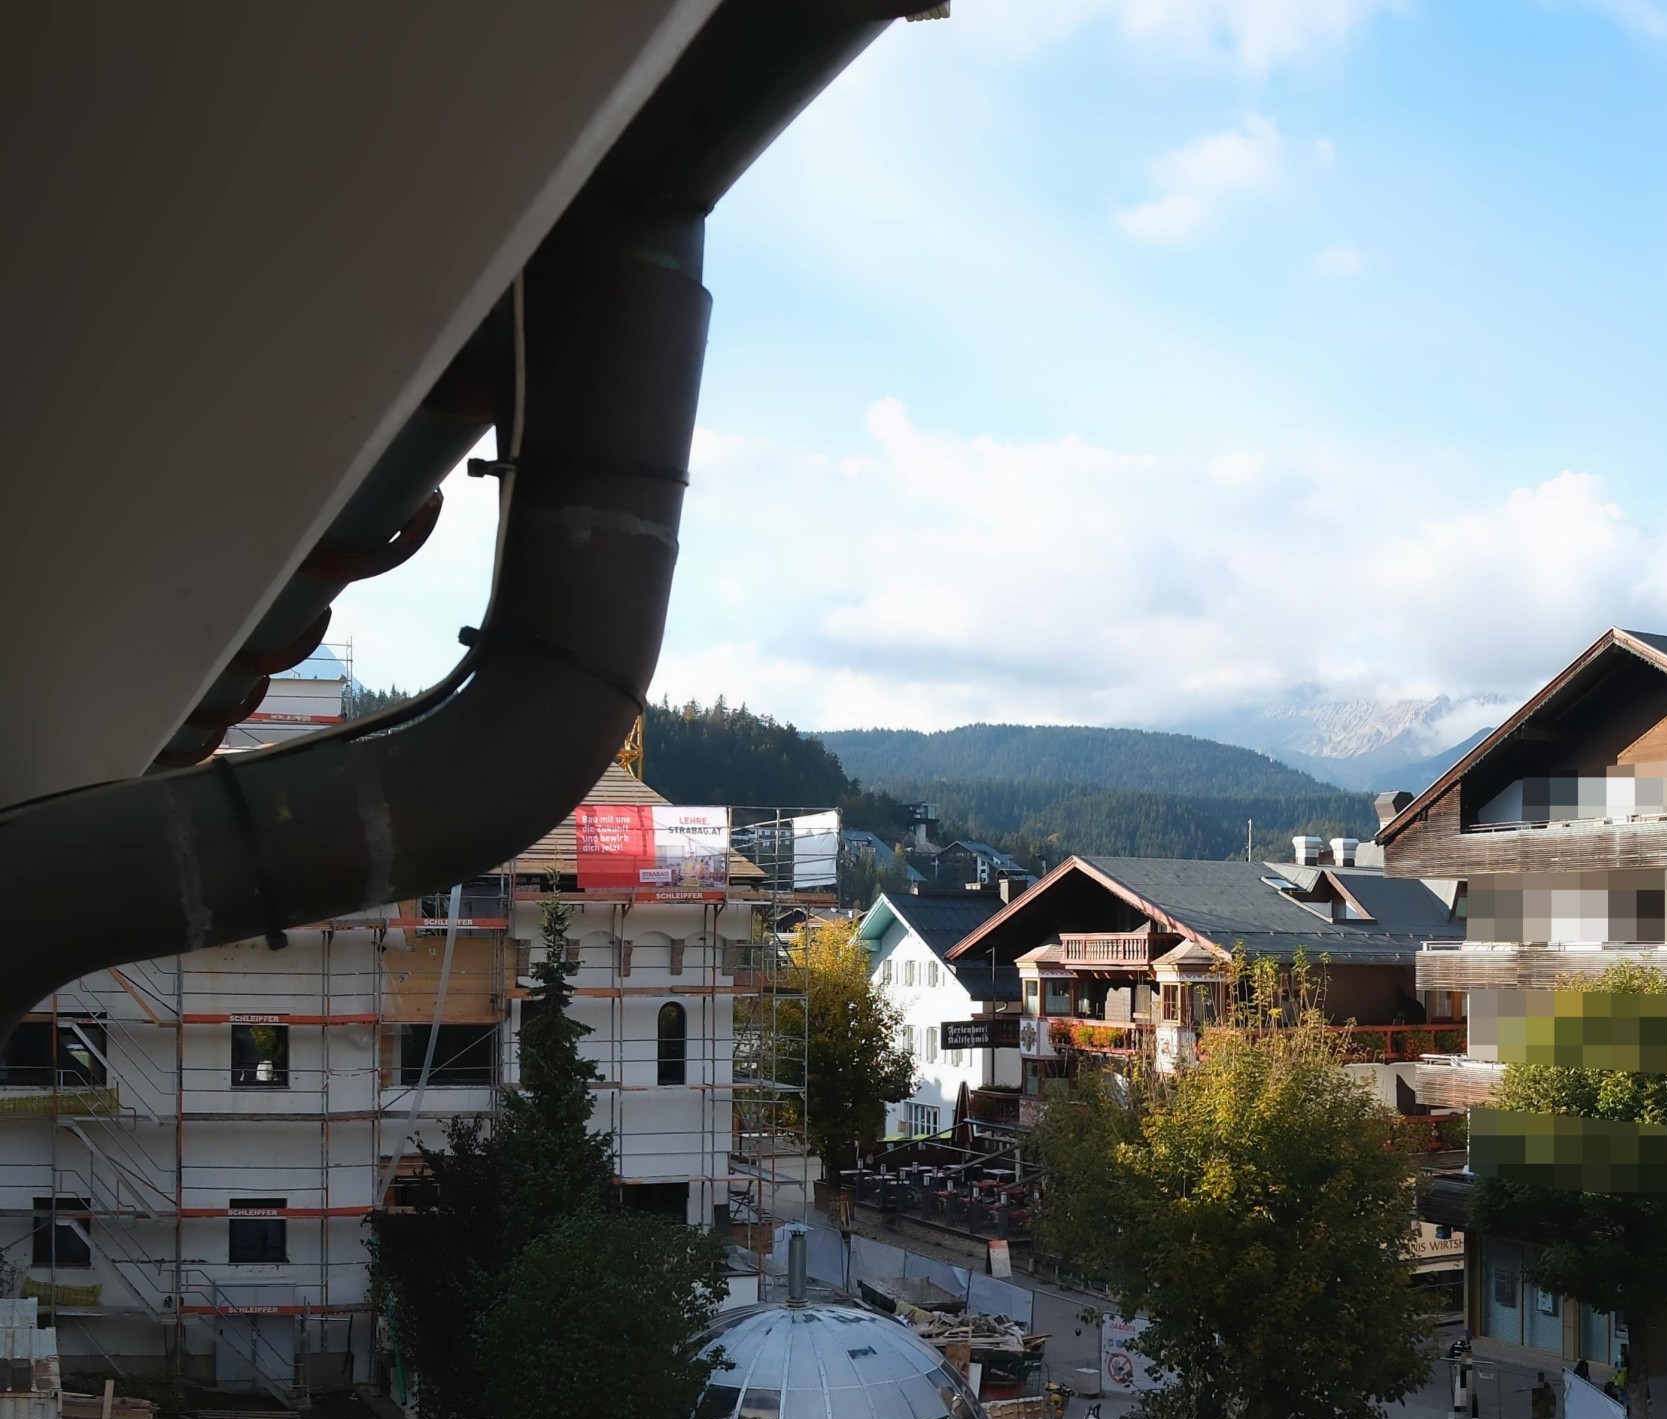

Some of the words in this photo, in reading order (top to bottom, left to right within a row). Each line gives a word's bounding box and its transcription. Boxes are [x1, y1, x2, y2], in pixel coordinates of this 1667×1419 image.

[581, 815, 598, 824] Bau
[600, 816, 614, 824] mit
[679, 816, 710, 825] LEHRE.
[582, 824, 594, 833] die
[597, 824, 629, 833] Zukunft
[668, 826, 722, 836] STRABAG.AT
[582, 834, 598, 843] und
[601, 834, 629, 843] bewirb
[582, 844, 600, 852] dich
[601, 844, 623, 853] jetzt!
[947, 1024, 988, 1036] Ferienhotel
